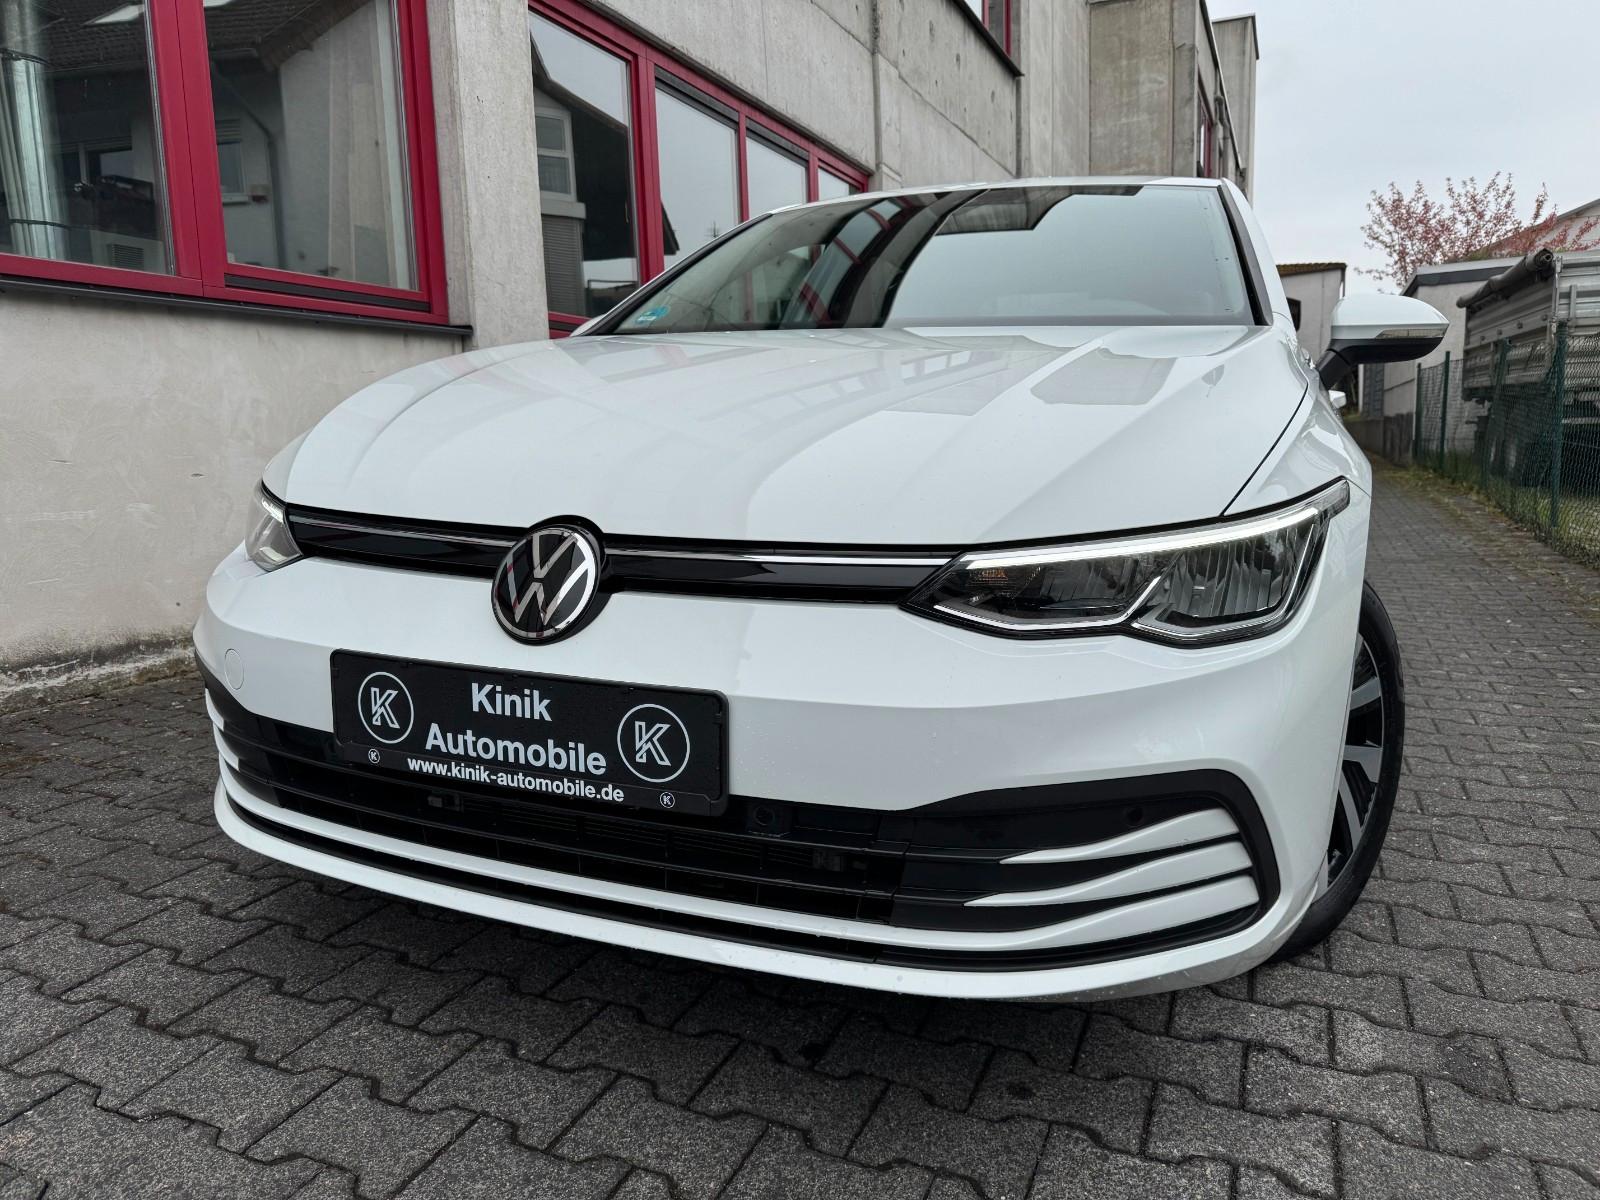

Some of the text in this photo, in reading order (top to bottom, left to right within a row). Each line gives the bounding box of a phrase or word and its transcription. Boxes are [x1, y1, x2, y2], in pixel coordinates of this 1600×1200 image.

[471, 682, 552, 722] Kinik
[425, 723, 607, 775] Automobile
[406, 757, 625, 802] www.kinik-automobile.de
